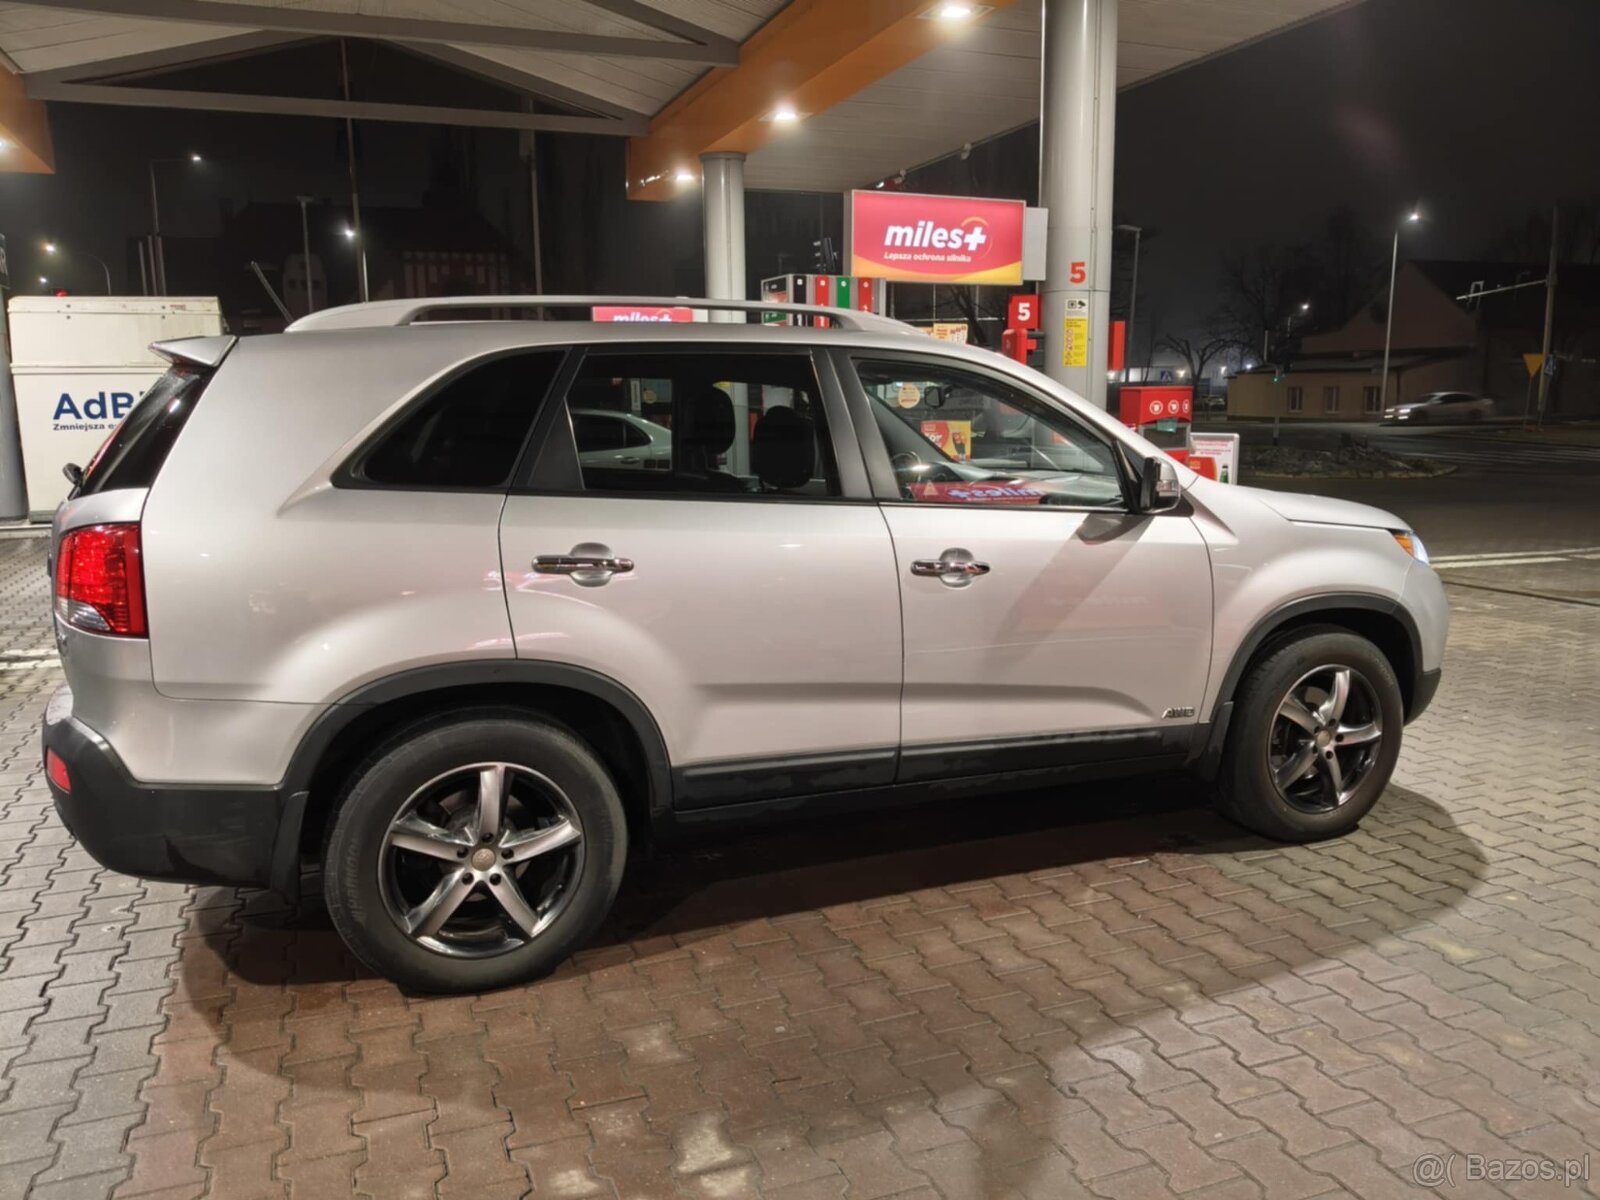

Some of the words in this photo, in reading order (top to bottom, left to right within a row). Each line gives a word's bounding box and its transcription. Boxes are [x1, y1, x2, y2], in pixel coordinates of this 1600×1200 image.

[884, 220, 986, 251] miles+
[913, 253, 945, 263] ochrona
[1070, 262, 1086, 284] 5
[1018, 302, 1031, 321] 5
[53, 391, 145, 420] AdB
[53, 423, 105, 432] Zmniejsza
